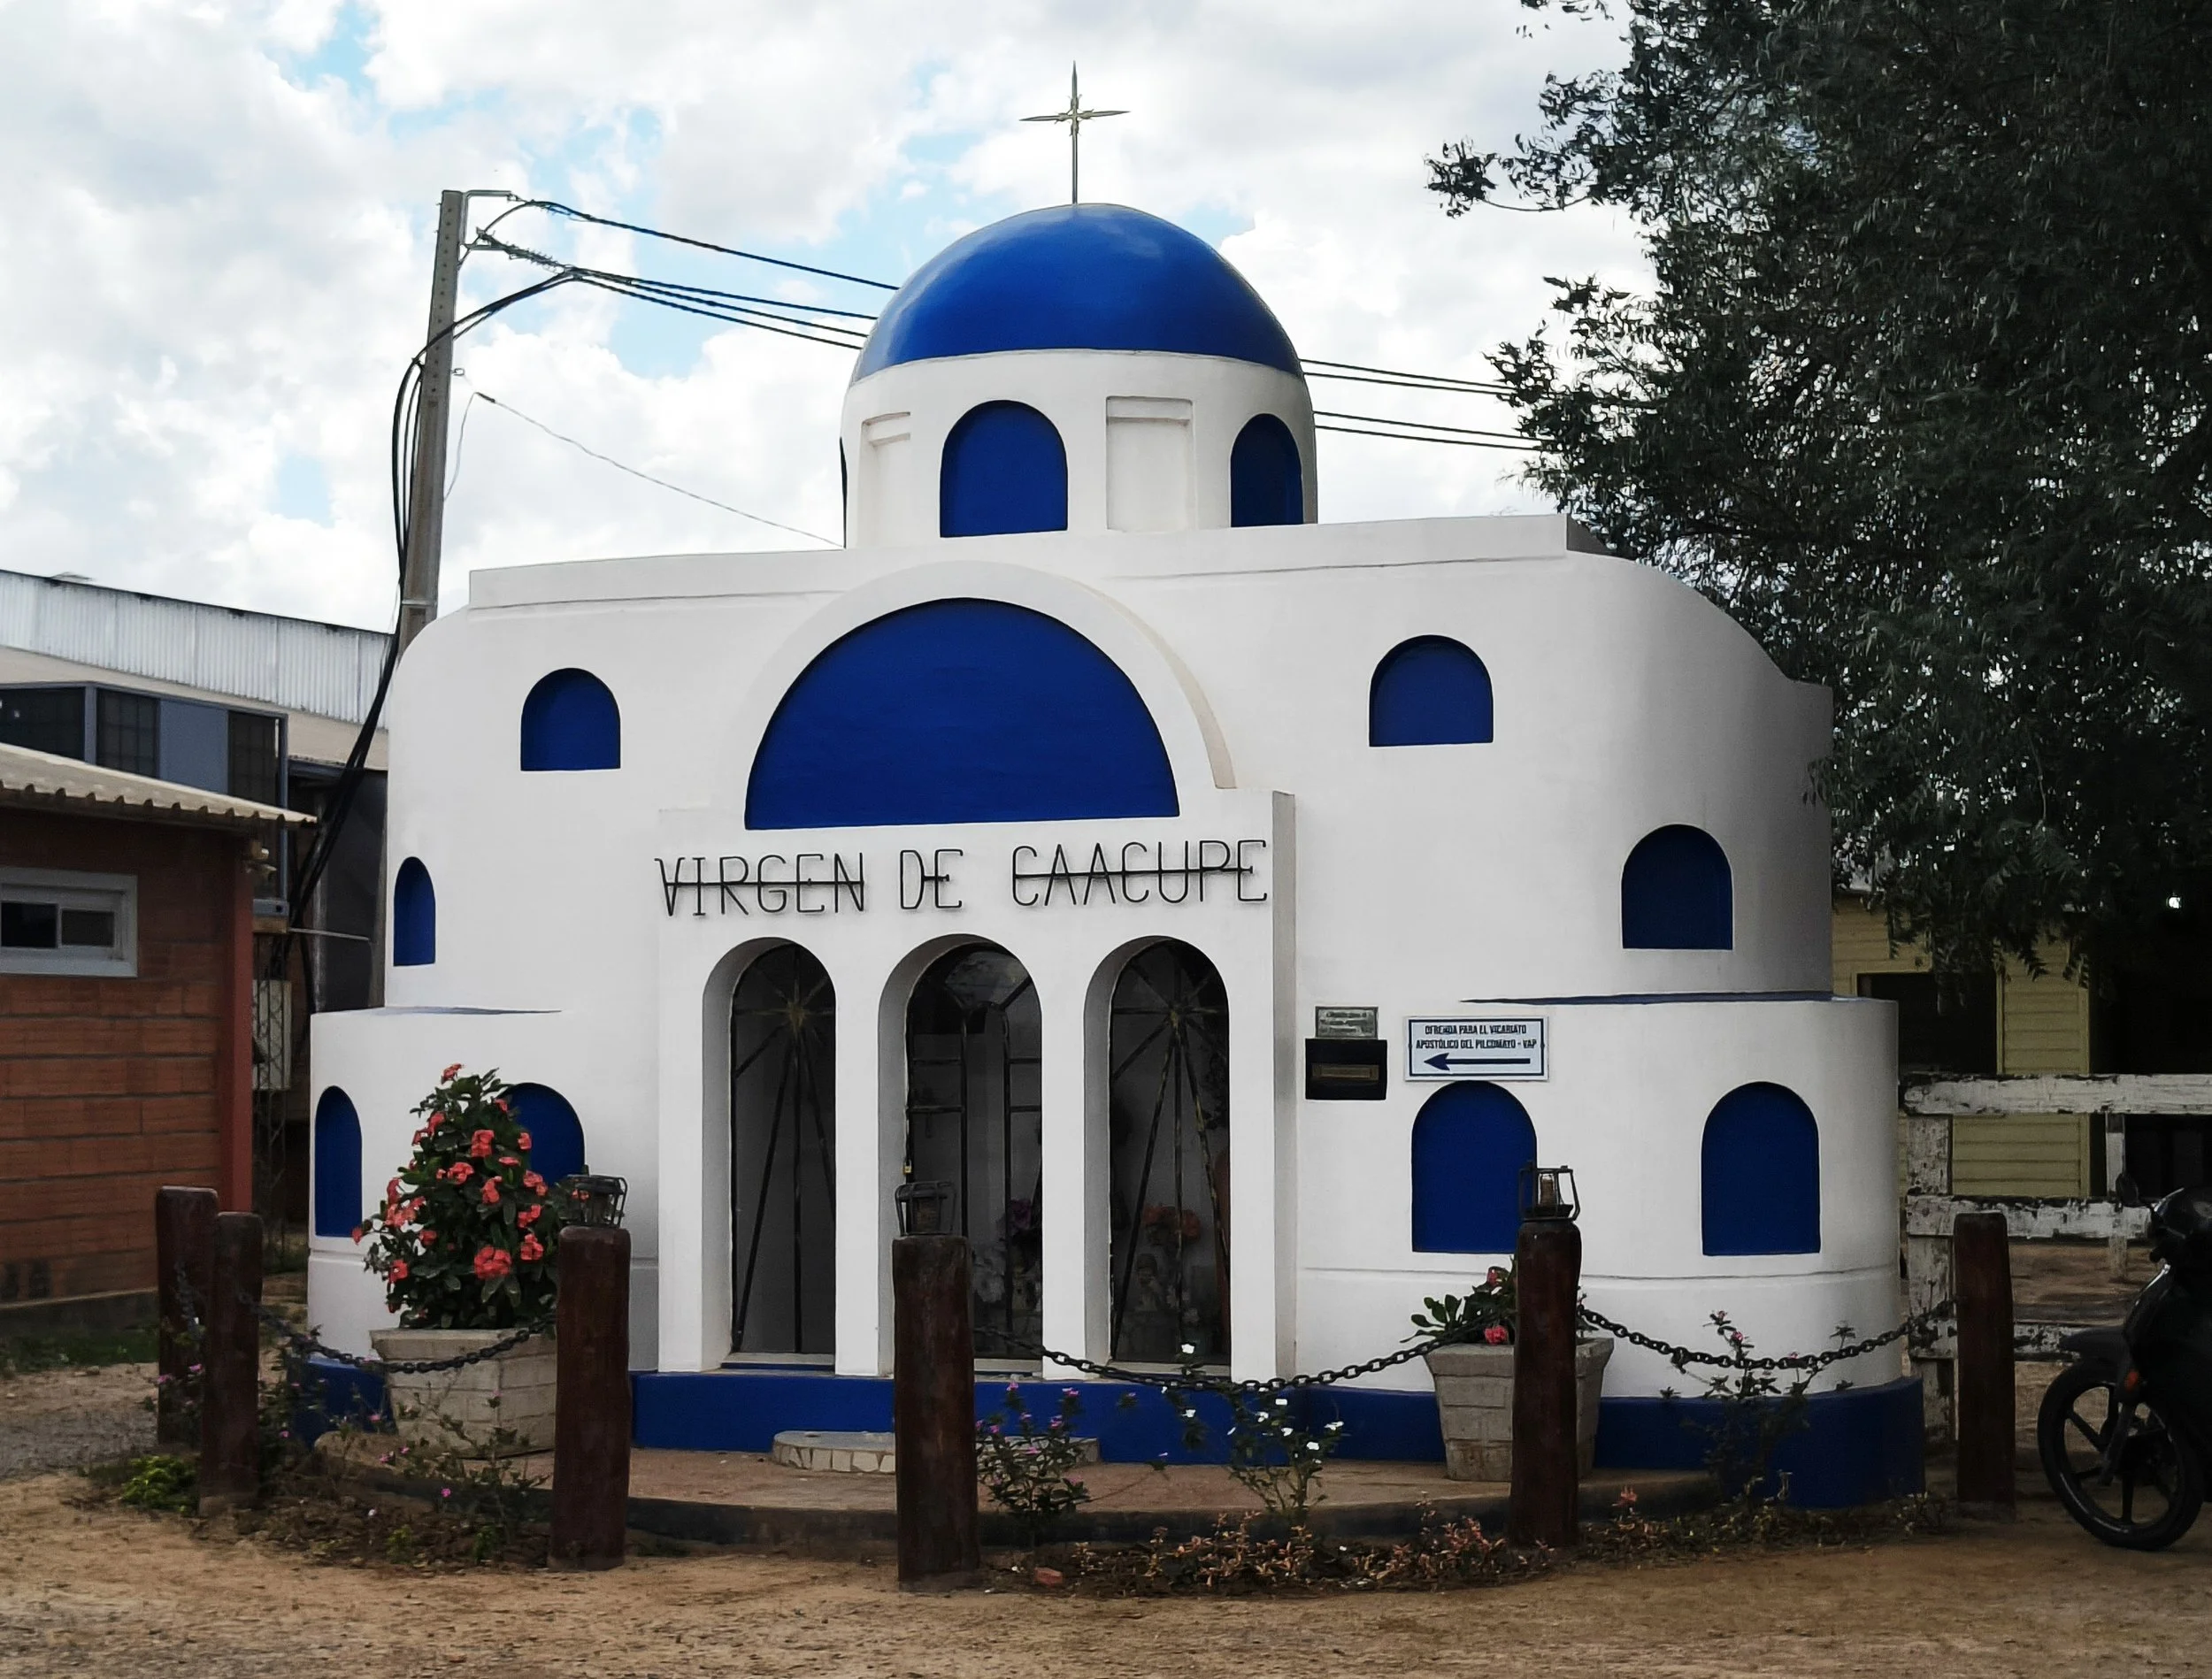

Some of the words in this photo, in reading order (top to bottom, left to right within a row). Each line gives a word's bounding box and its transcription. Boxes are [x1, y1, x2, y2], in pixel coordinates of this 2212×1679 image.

[654, 852, 865, 916] VIRGEN
[899, 848, 964, 909] DE
[1012, 840, 1268, 907] CAACUPE
[1459, 1024, 1478, 1034] PARA
[1479, 1024, 1488, 1034] EL
[1460, 1039, 1474, 1049] DEL
[1523, 1039, 1537, 1049] VAP
